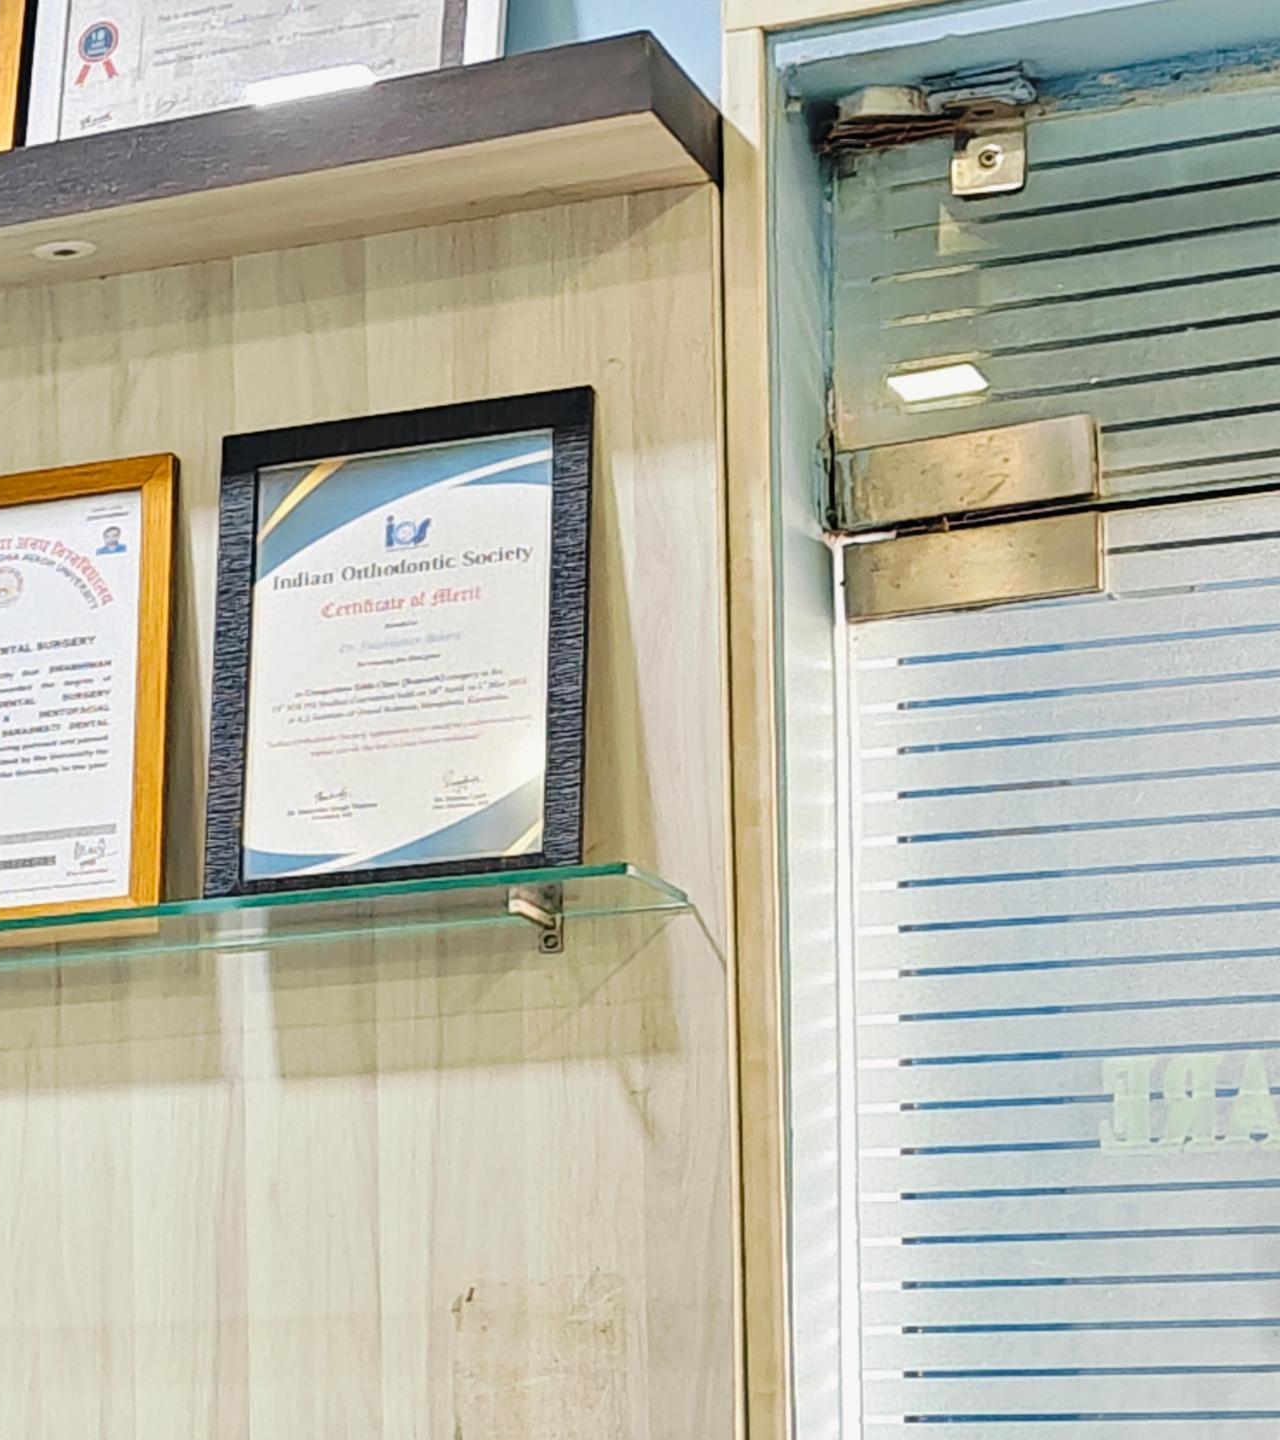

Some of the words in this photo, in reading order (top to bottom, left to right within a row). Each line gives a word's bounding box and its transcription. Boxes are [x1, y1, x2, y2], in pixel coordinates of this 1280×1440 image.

[272, 569, 334, 592] Indian
[341, 554, 456, 582] Orthodontic
[462, 546, 534, 568] Society
[321, 597, 405, 619] Certificate
[411, 592, 425, 609] of
[431, 586, 482, 607] Merit
[37, 635, 96, 651] SURGERY
